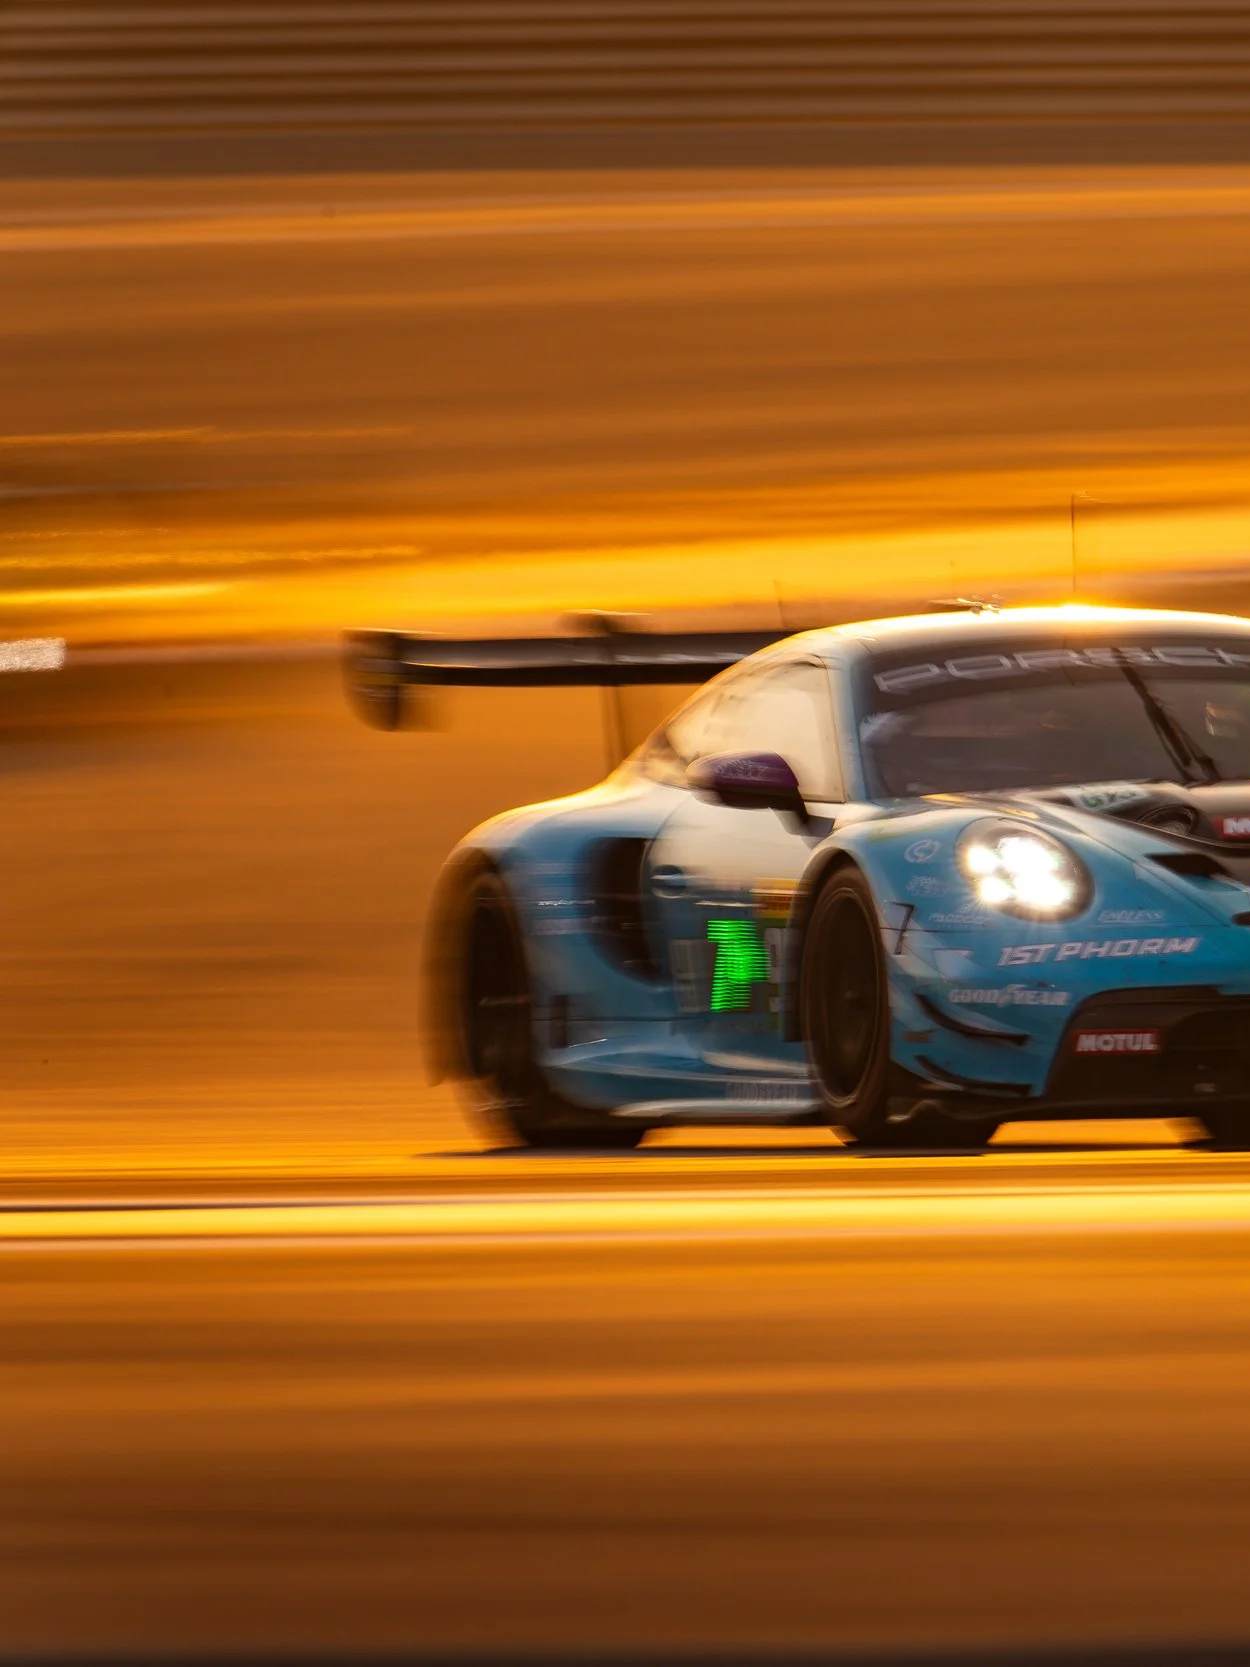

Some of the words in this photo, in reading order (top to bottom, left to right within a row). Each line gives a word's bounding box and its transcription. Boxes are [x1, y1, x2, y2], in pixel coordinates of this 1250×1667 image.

[997, 943, 1056, 967] 1ST
[1053, 937, 1198, 963] PHORM
[1076, 1034, 1158, 1051] MOTUL
